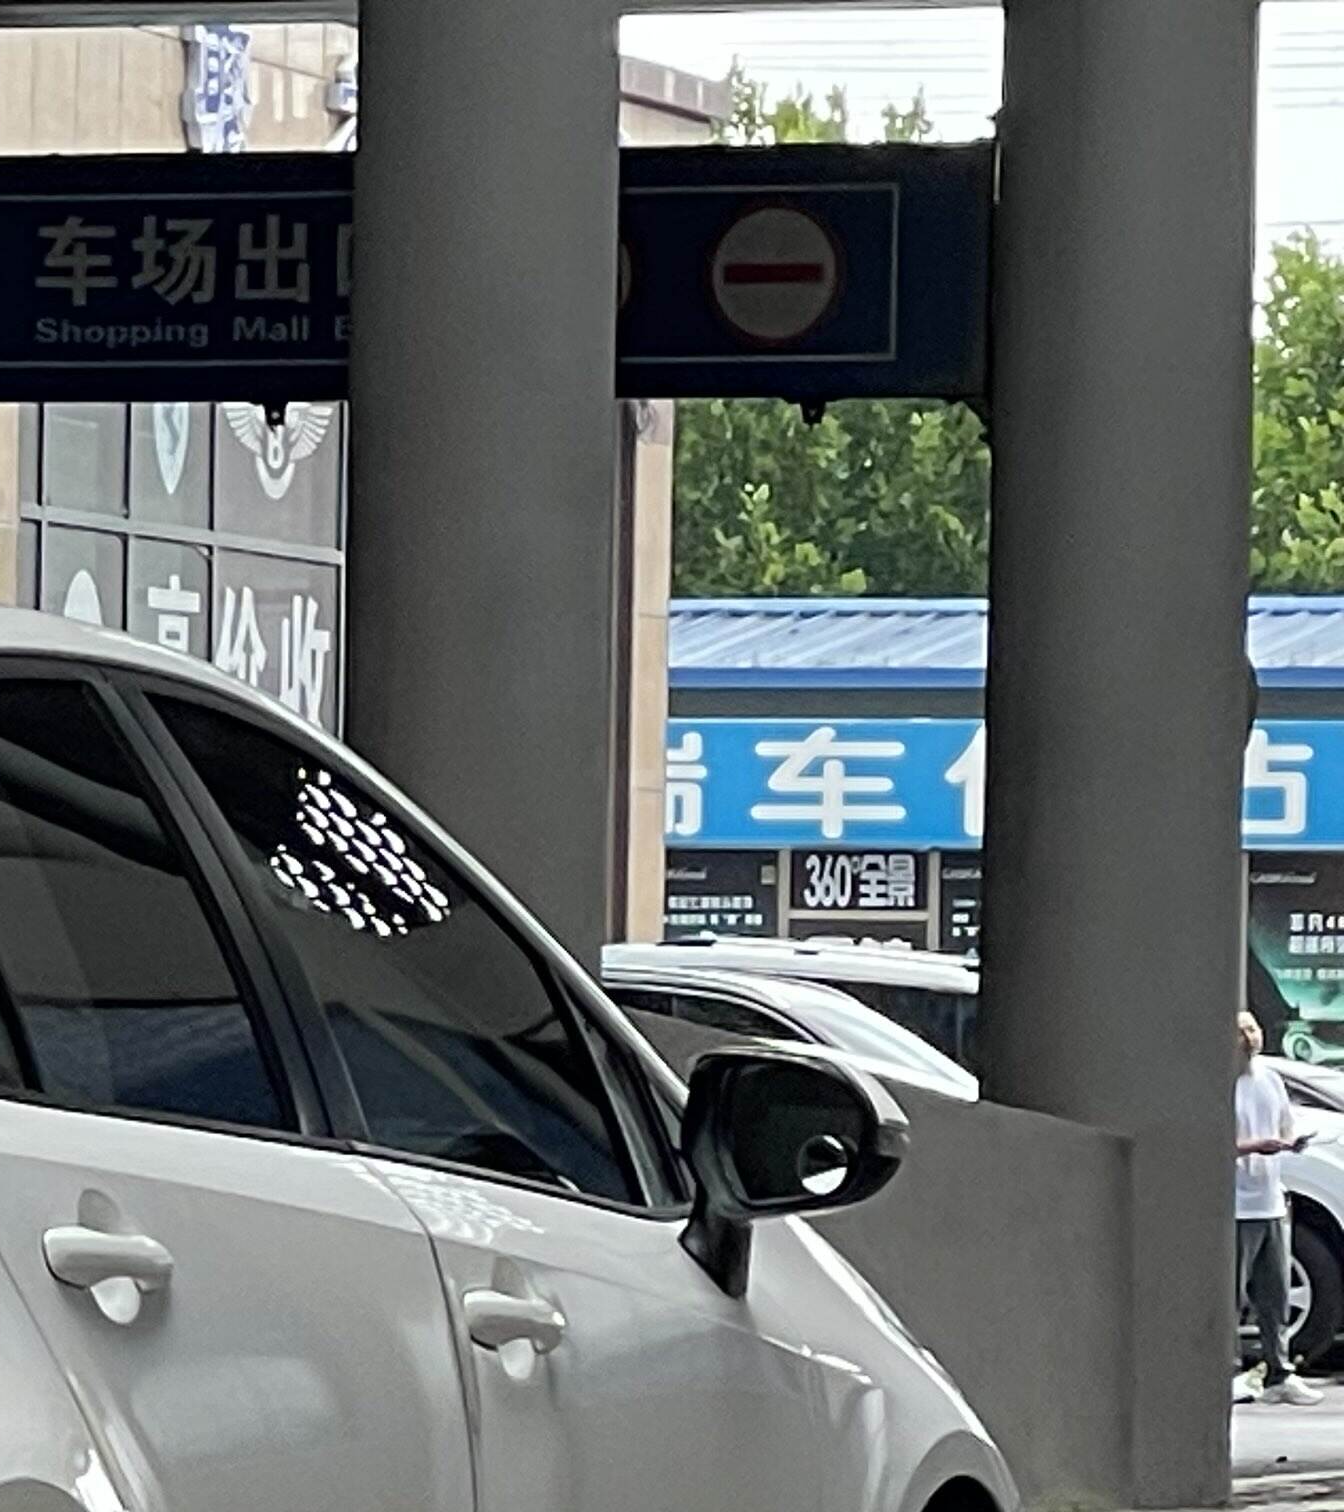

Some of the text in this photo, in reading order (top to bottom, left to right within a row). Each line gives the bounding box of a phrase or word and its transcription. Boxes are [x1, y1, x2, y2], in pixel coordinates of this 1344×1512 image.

[35, 215, 353, 306] 车场出
[35, 316, 209, 347] Shopping
[232, 315, 310, 343] Mall
